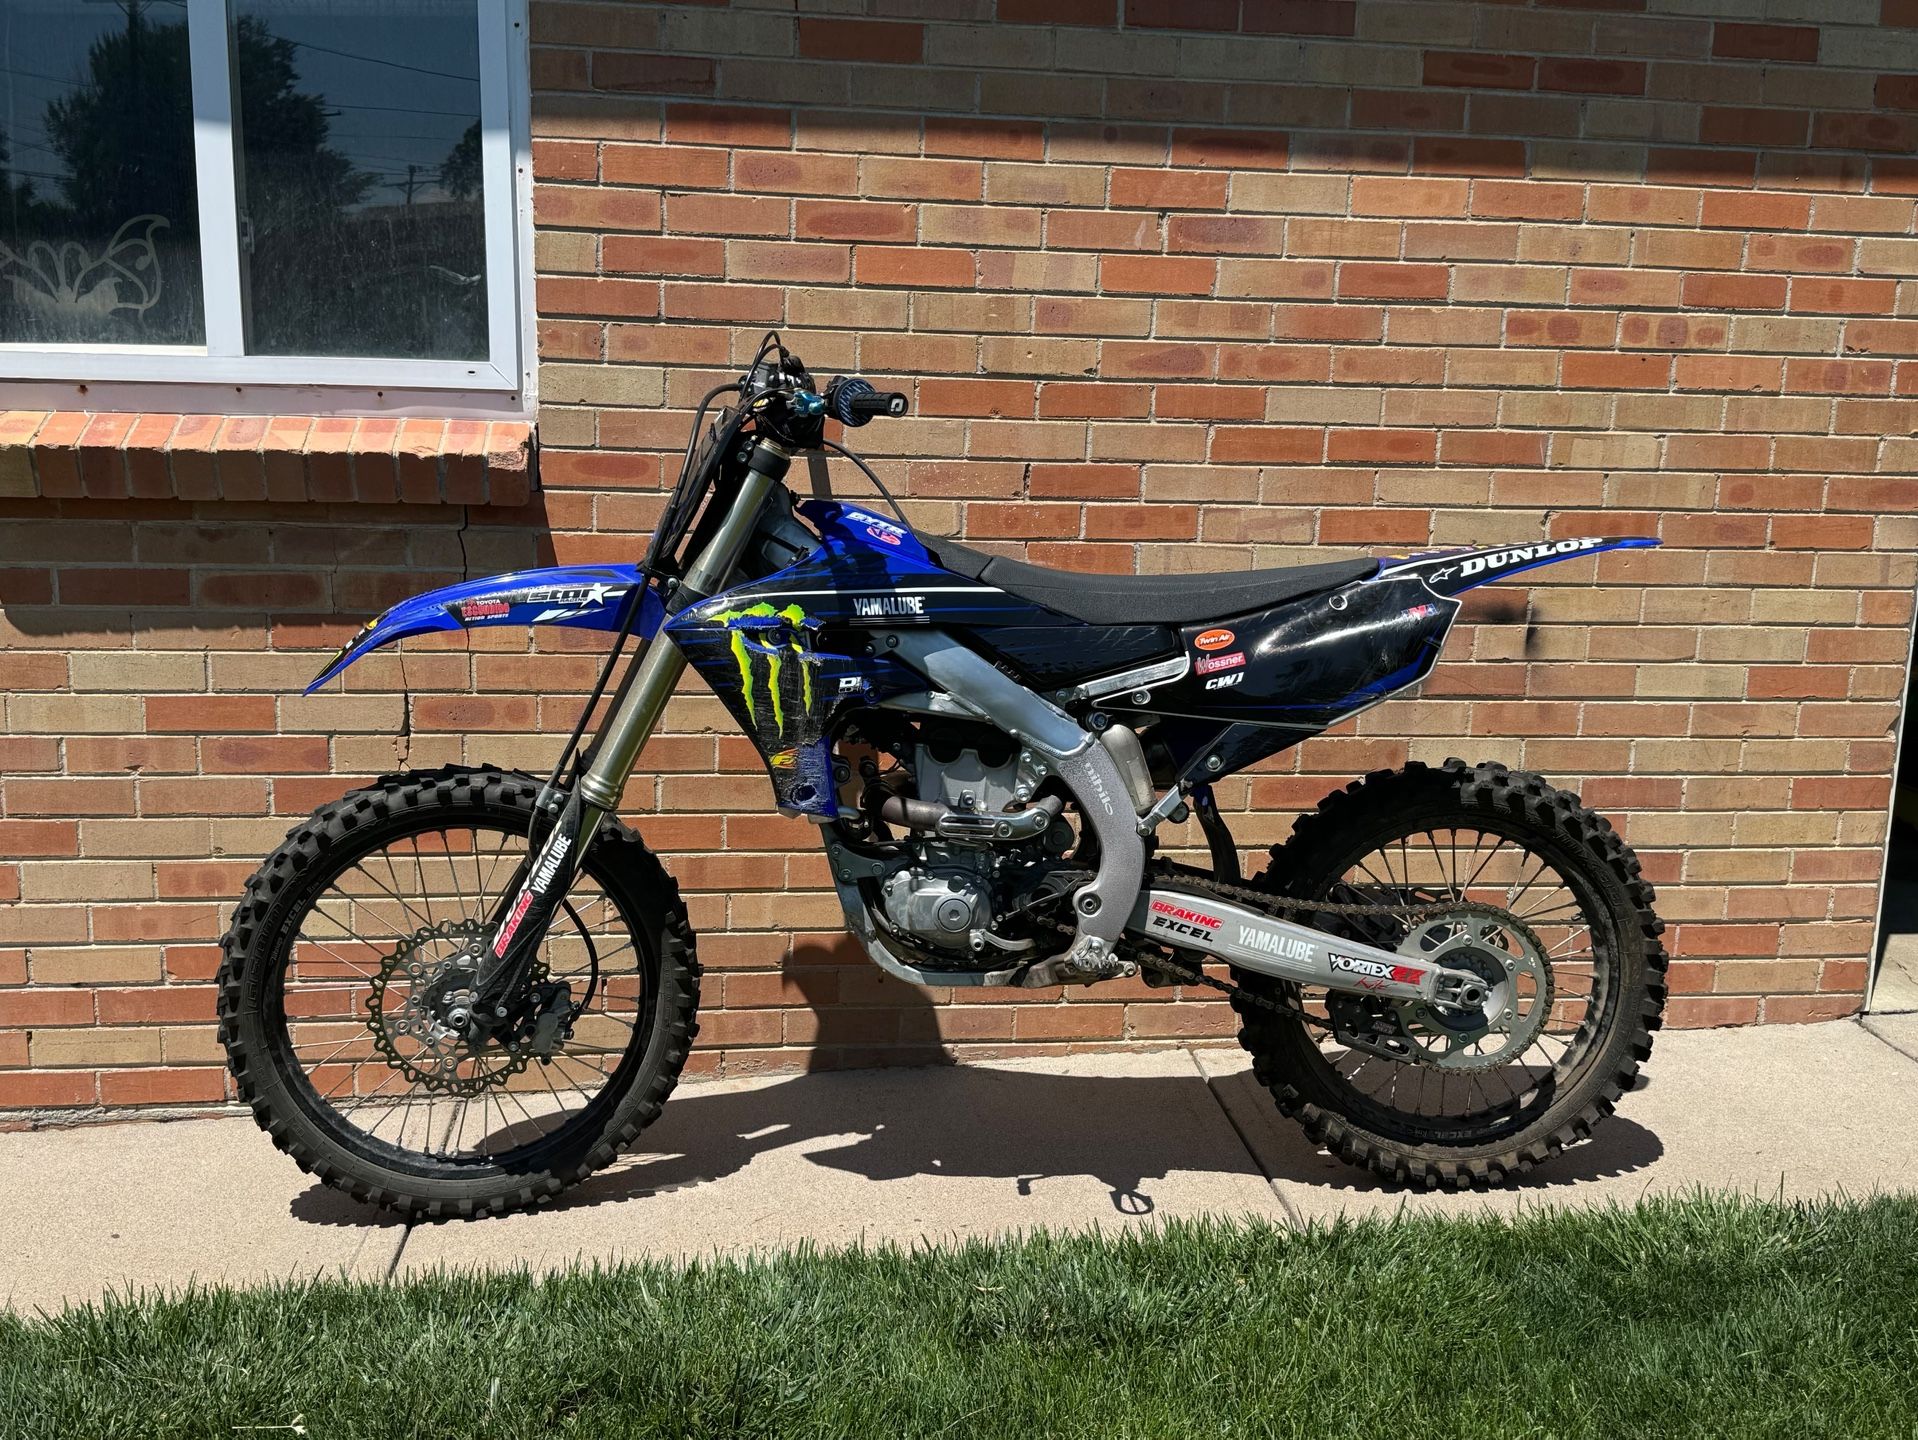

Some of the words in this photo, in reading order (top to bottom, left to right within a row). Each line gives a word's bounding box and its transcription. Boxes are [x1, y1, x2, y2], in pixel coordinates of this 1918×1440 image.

[1459, 537, 1603, 578] DUNLOP
[853, 596, 925, 616] YAMALUBE
[1199, 636, 1218, 646] Twin
[1218, 633, 1232, 642] Air
[531, 833, 572, 894] YAMALUBE
[280, 897, 307, 934] EXCEL
[495, 890, 534, 958] BRAKING
[1151, 901, 1224, 930] BRAKING
[1152, 916, 1214, 943] EXCEL
[1238, 925, 1316, 963] YAMALUBE
[1328, 952, 1396, 980] VORTEX
